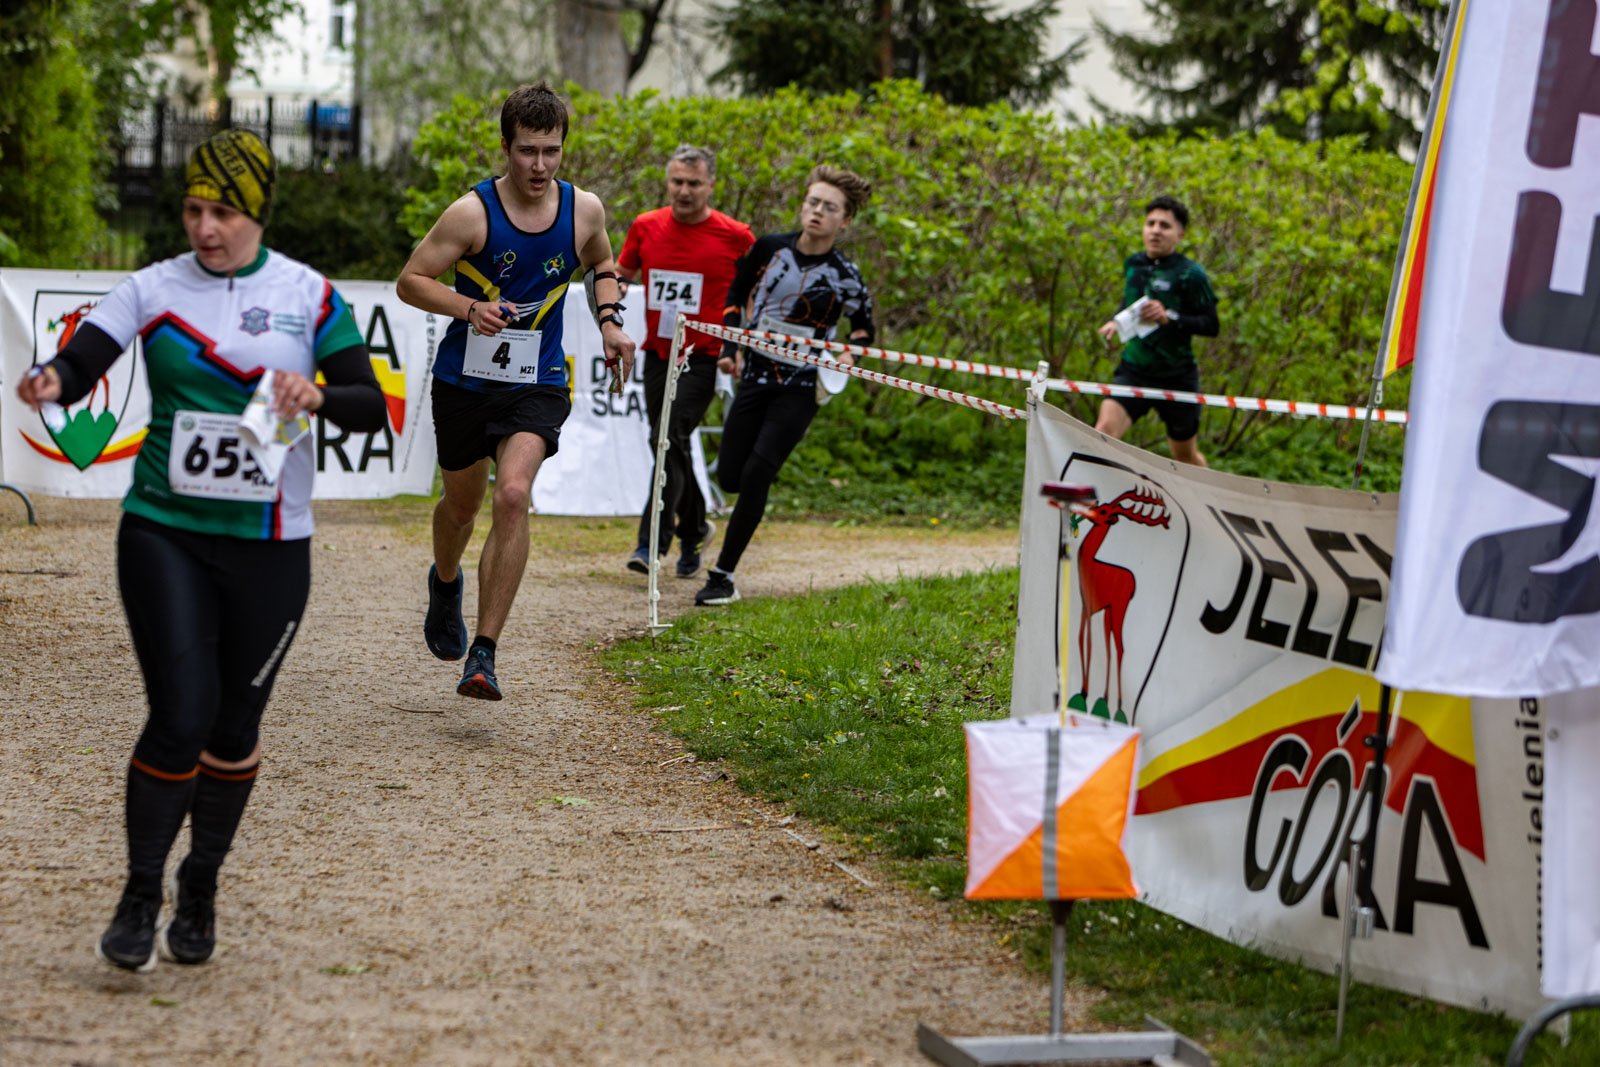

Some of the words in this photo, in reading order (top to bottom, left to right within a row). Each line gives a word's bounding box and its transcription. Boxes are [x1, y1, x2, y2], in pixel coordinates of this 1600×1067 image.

[654, 281, 692, 301] 754
[491, 341, 511, 370] 4
[519, 365, 535, 375] M21
[1243, 698, 1490, 950] GÓRA
